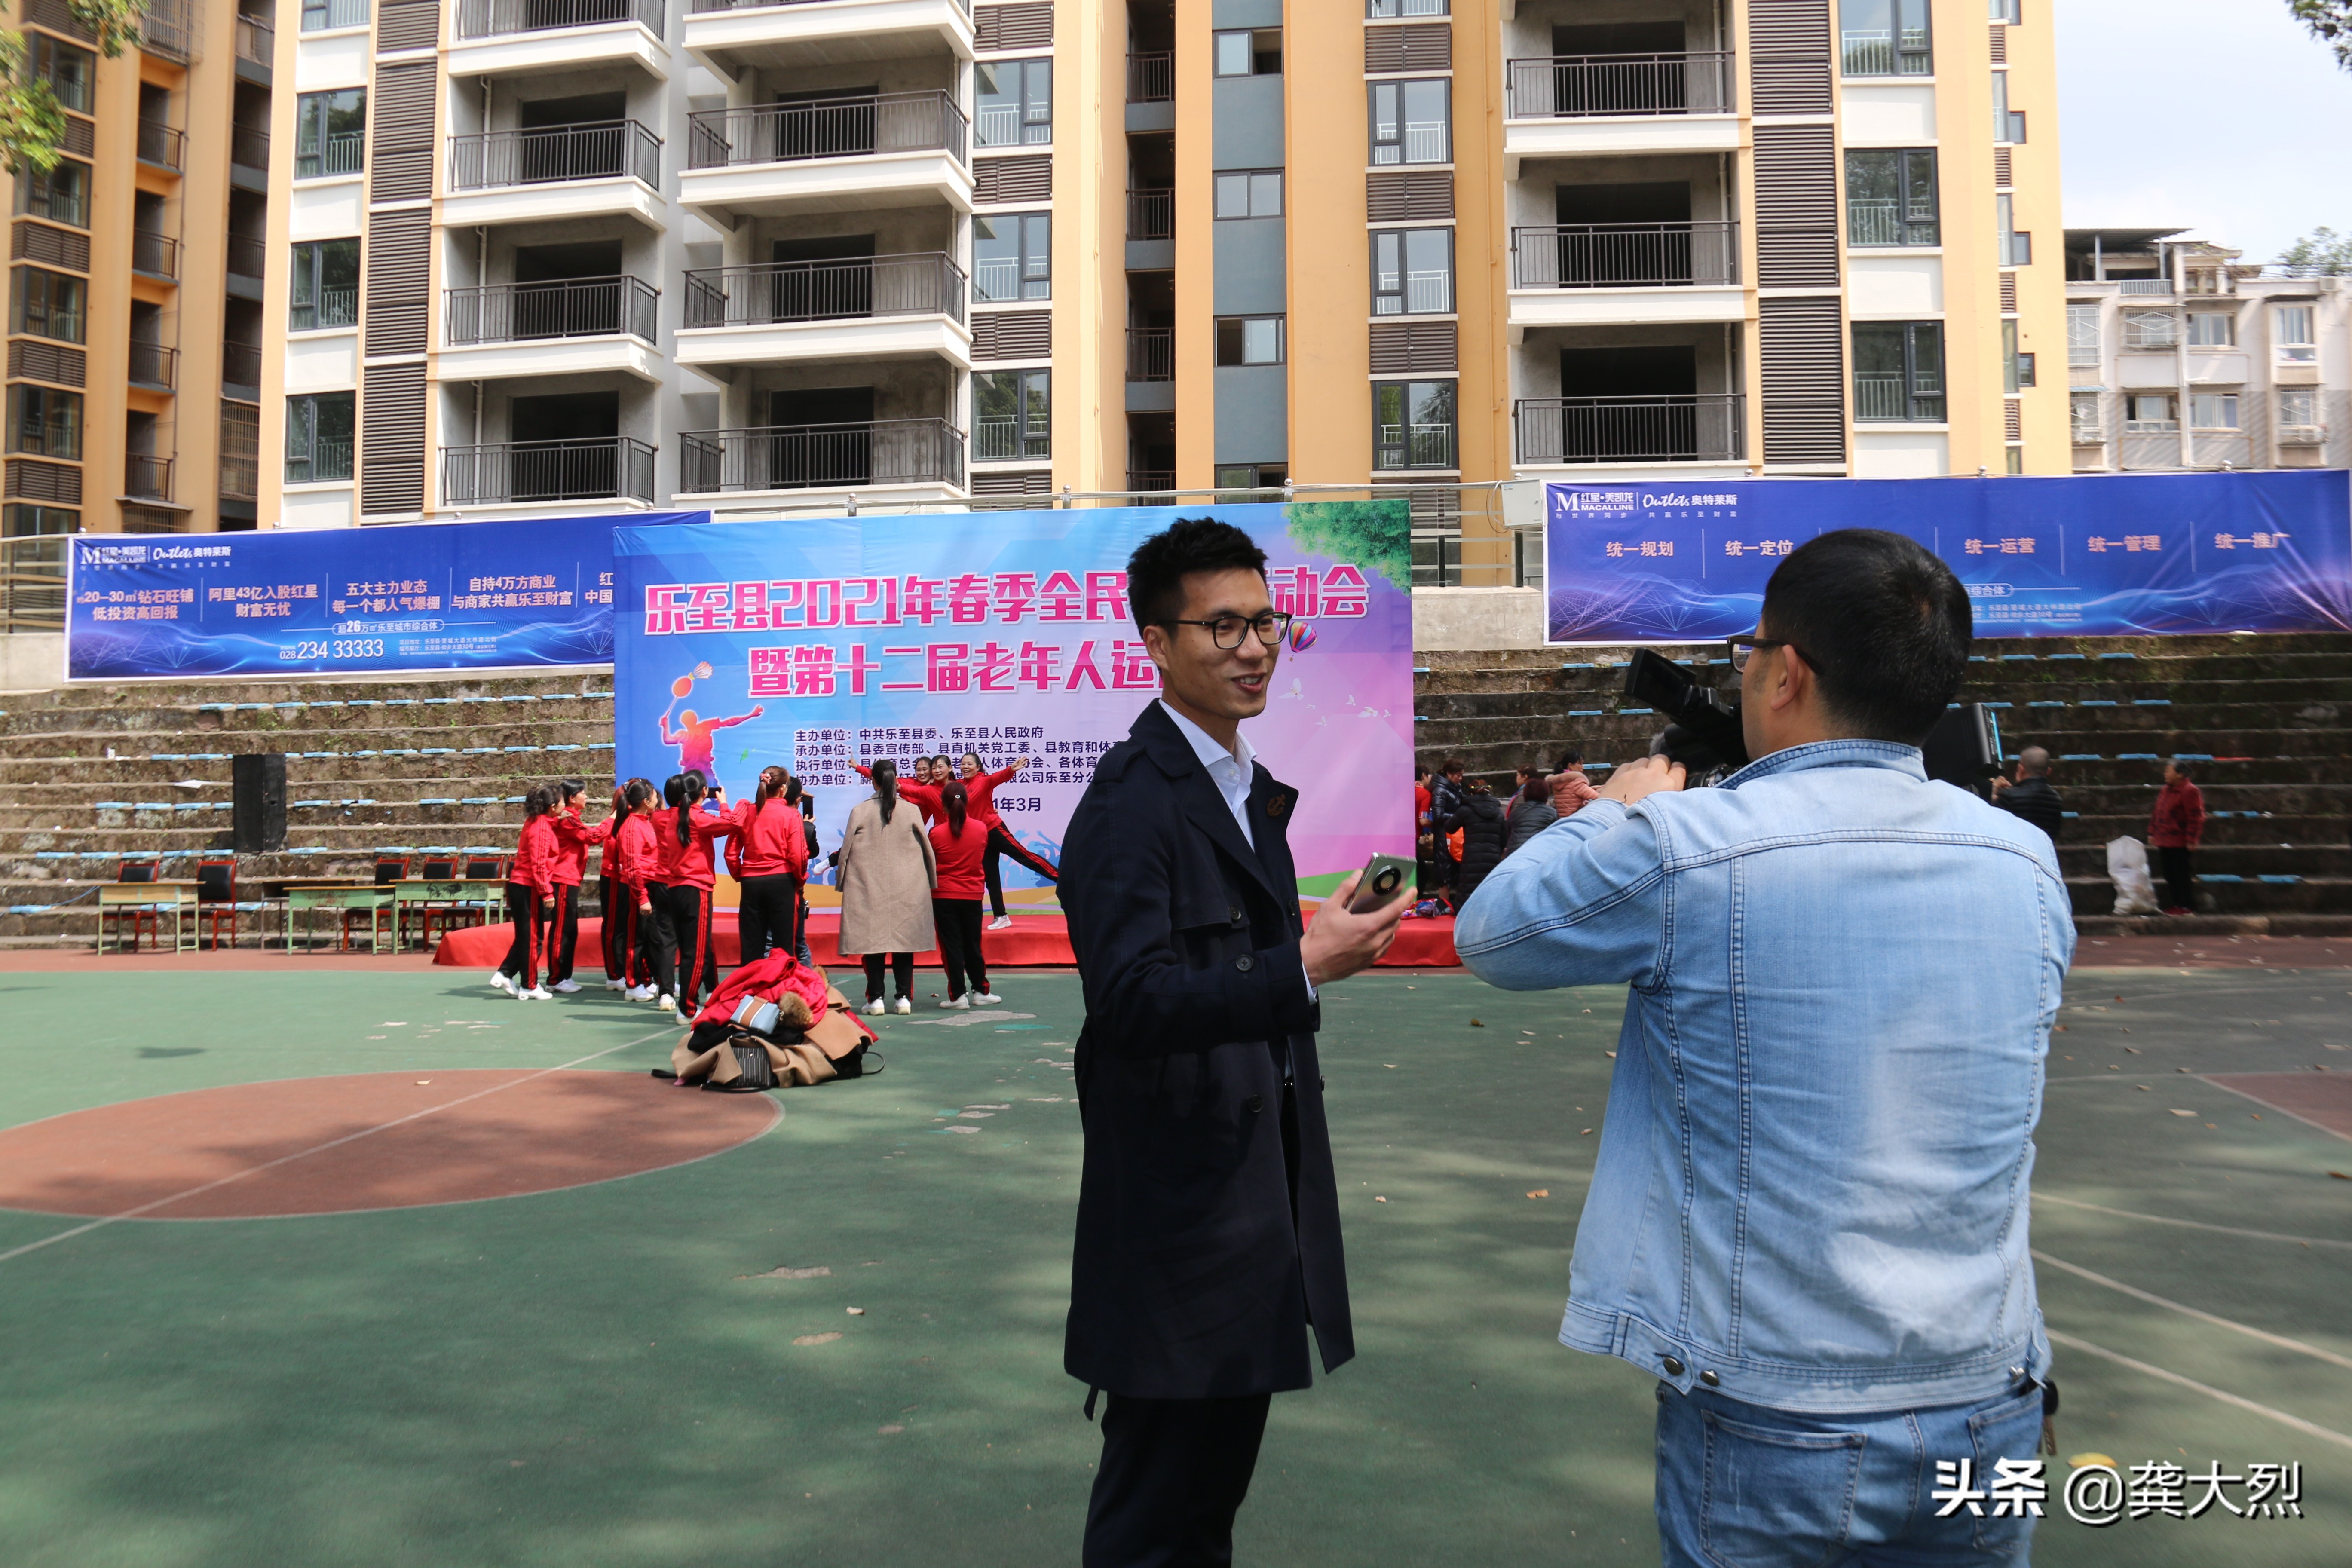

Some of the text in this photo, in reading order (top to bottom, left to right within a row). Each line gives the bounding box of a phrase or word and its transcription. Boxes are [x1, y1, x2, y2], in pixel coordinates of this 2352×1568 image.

[1556, 493, 1580, 511] M
[1581, 492, 1633, 502] 红星·美凯龙
[1642, 492, 1690, 508] Outlets
[1691, 494, 1737, 505] 奥特莱斯
[1606, 541, 1673, 557] 统一规划
[1725, 539, 1794, 556] 统一定位
[1965, 537, 2035, 555] 统一运营
[2088, 535, 2162, 553] 统一管理
[2215, 532, 2291, 550] 统一推广
[153, 546, 193, 560] Outlets
[193, 546, 231, 557] 奥特莱斯
[346, 579, 427, 597] 五大主力业态
[469, 574, 556, 592] 自持4万方商业
[208, 584, 318, 602] 阿里43亿入股红星
[451, 591, 573, 609] 与商家共赢乐至财富
[585, 589, 613, 604] 中国
[645, 564, 1370, 635] 乐至县2021年春季全民动会
[93, 605, 178, 621] 低投资高回报
[236, 602, 291, 618] 财富无忧
[332, 596, 441, 614] 每一个都人气爆棚
[280, 638, 384, 660] 028 234 33333
[748, 640, 1164, 699] 暨第十二届老年人运
[795, 741, 1118, 756] 承办单位：县委宣传部、县直机关党工委、县教育和体
